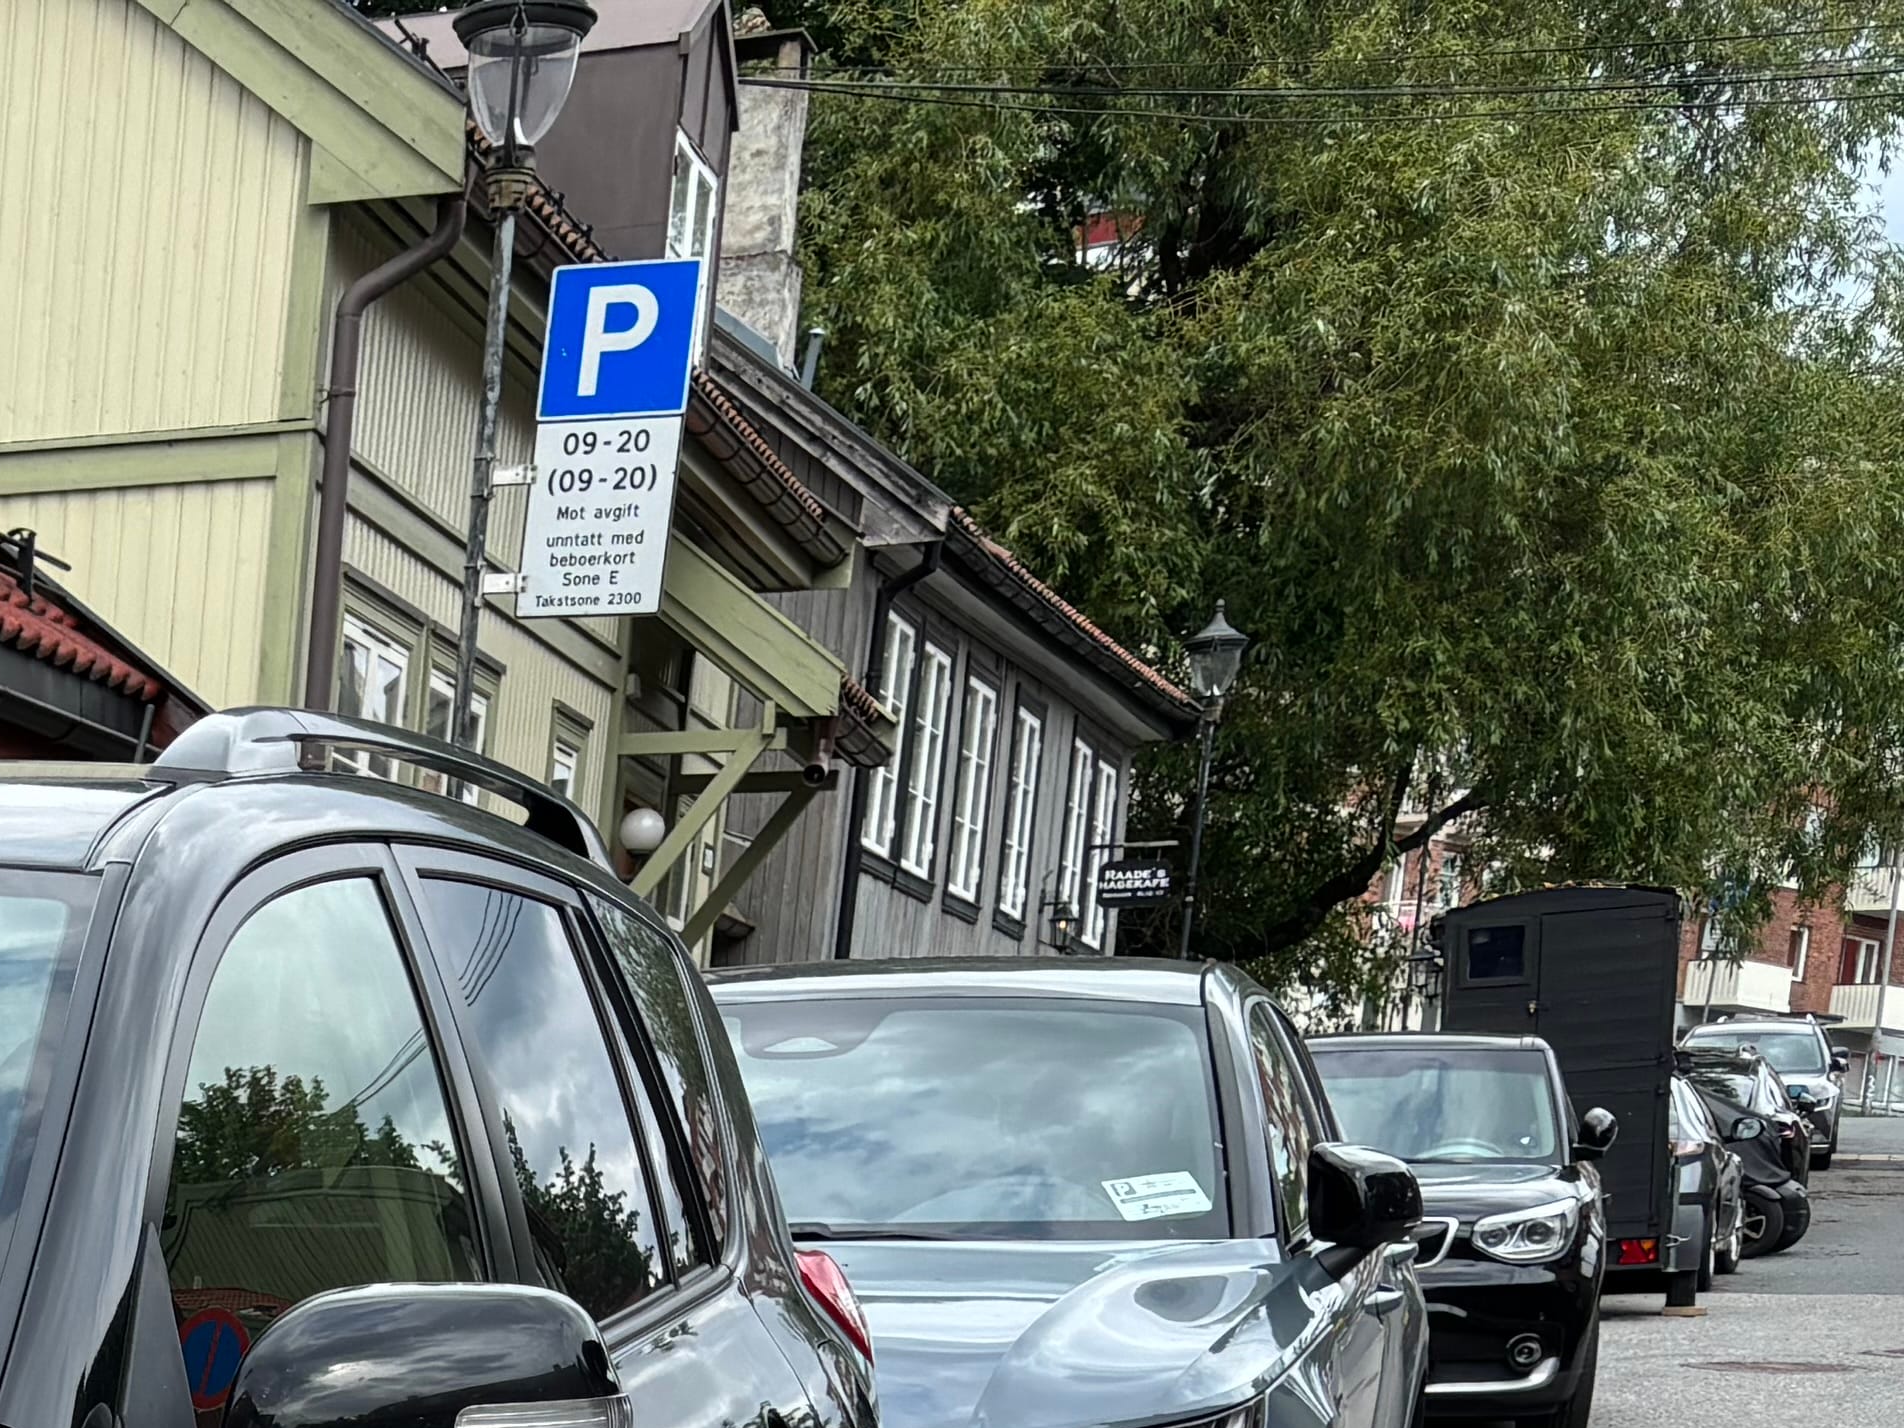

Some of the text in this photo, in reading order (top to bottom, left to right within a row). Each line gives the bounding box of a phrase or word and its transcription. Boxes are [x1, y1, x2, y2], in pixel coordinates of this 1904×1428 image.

[577, 284, 659, 397] P
[563, 429, 650, 456] 09-20
[547, 464, 657, 494] (09-20)
[557, 504, 639, 522] Mot avgift
[546, 530, 644, 548] unntatt med
[549, 551, 635, 567] beboerkort
[562, 570, 619, 586] Sone E
[535, 592, 641, 608] Takstsone 2300
